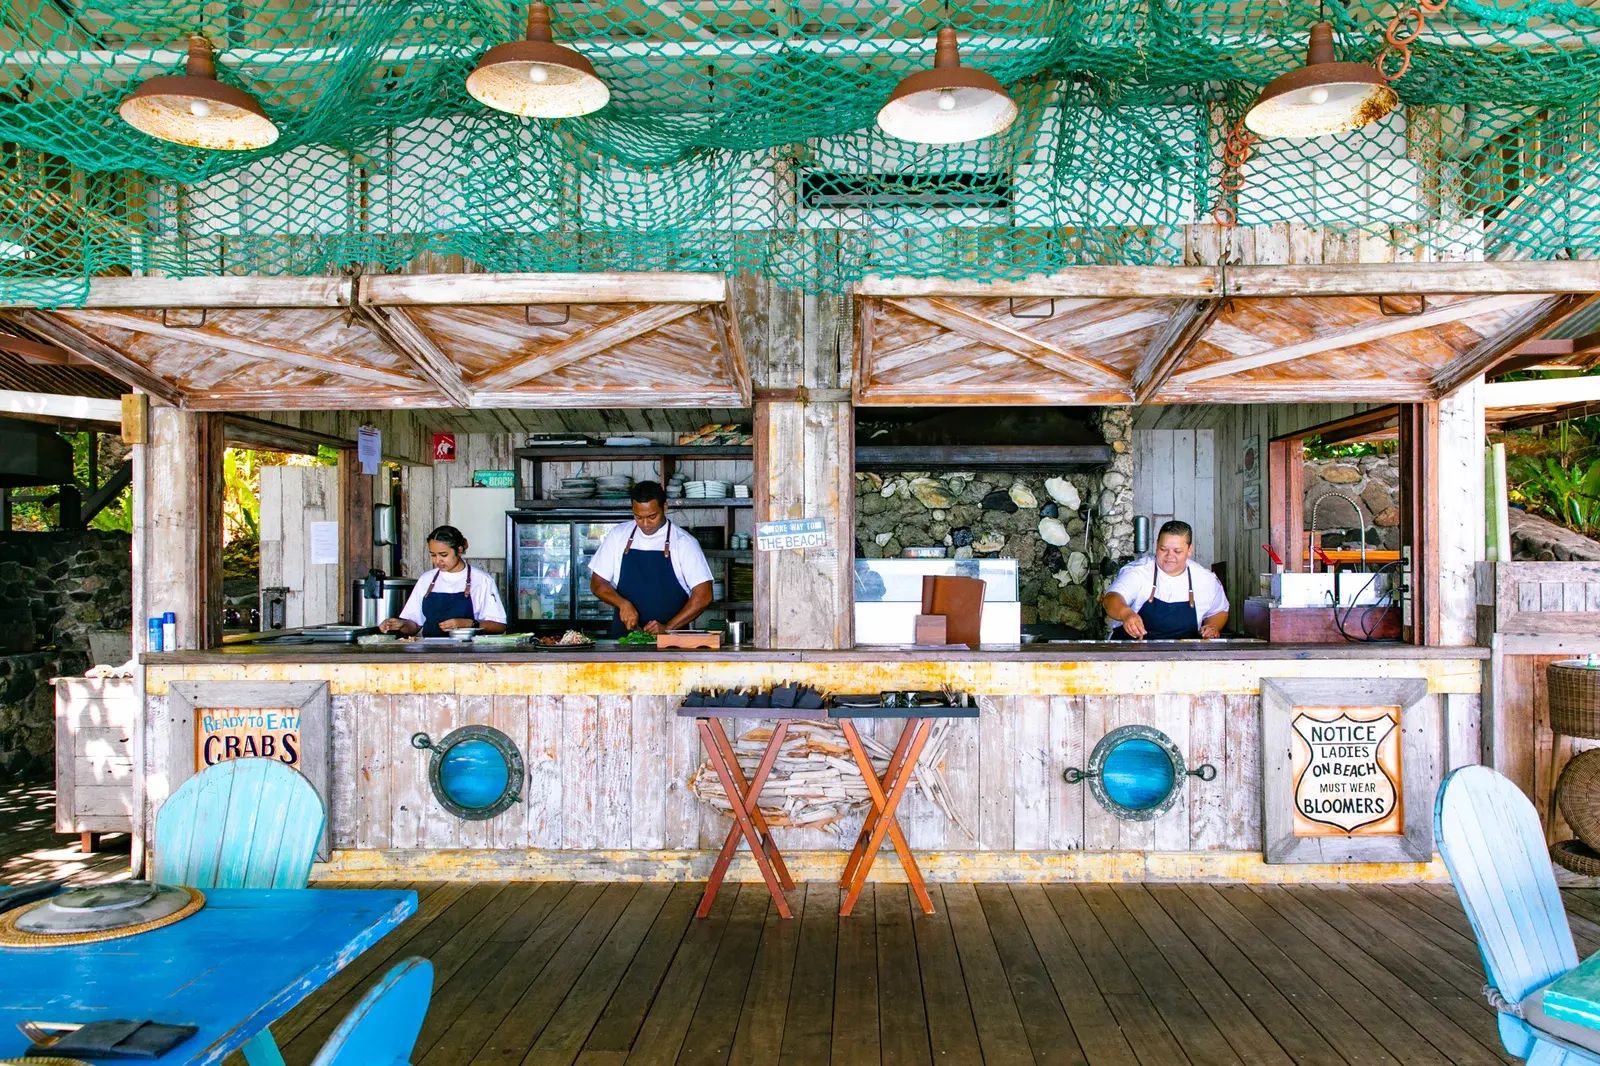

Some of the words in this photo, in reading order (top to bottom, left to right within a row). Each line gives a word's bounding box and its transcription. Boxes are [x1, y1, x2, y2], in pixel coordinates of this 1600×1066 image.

[488, 476, 513, 487] BEACH
[774, 524, 788, 533] ONE
[791, 522, 804, 532] WAY
[806, 521, 815, 531] TO
[760, 537, 783, 550] THE
[785, 533, 824, 548] BEACH
[203, 715, 245, 733] READY
[248, 716, 264, 728] TO
[1311, 726, 1377, 742] NOTICE
[204, 733, 298, 766] CRABS
[1321, 746, 1370, 758] LADIES
[1312, 763, 1331, 777] ON
[1333, 762, 1377, 777] BEACH
[1319, 783, 1347, 793] MUST
[1349, 783, 1376, 793] WEAR
[1303, 797, 1385, 814] BLOOMERS
